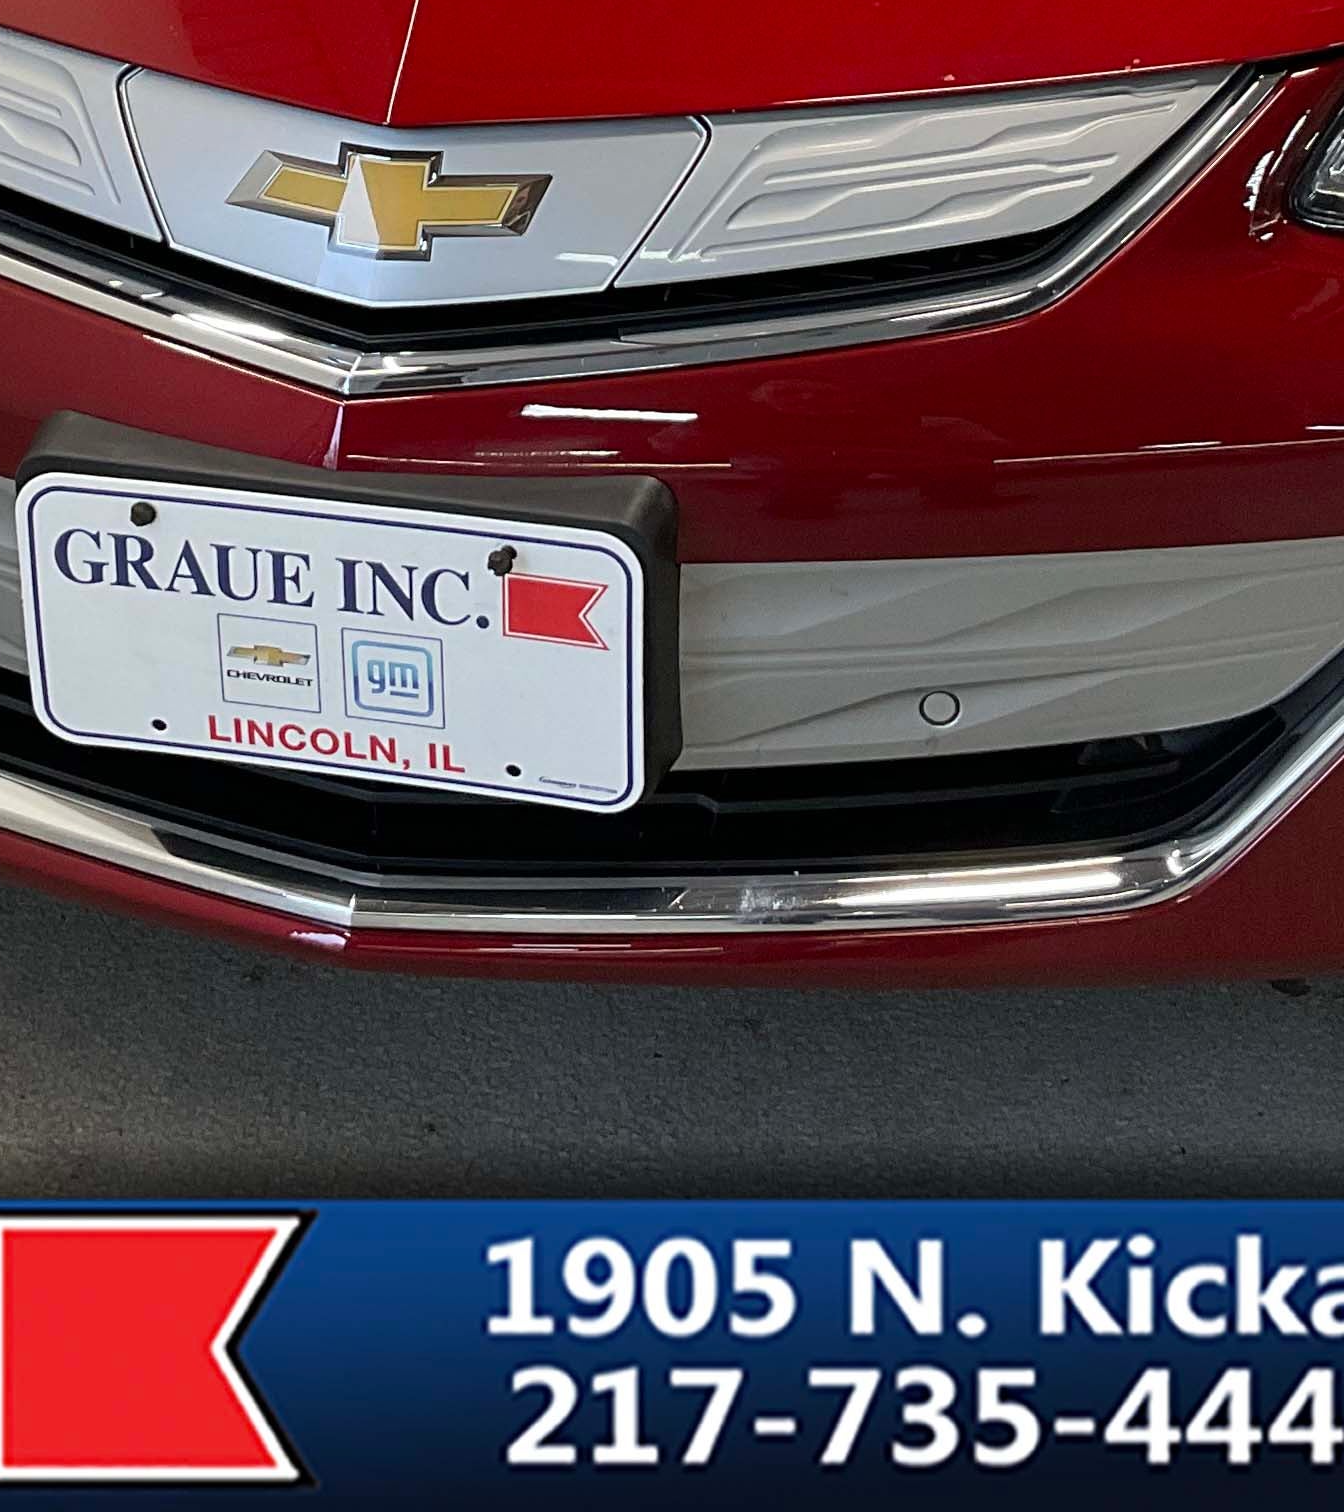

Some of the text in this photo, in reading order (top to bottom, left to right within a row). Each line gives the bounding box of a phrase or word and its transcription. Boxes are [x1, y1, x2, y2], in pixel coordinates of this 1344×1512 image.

[55, 529, 491, 630] GRAUE INC.
[226, 667, 315, 688] CHEVROLET
[368, 658, 419, 699] gm
[208, 715, 465, 774] LINCOLN, IL
